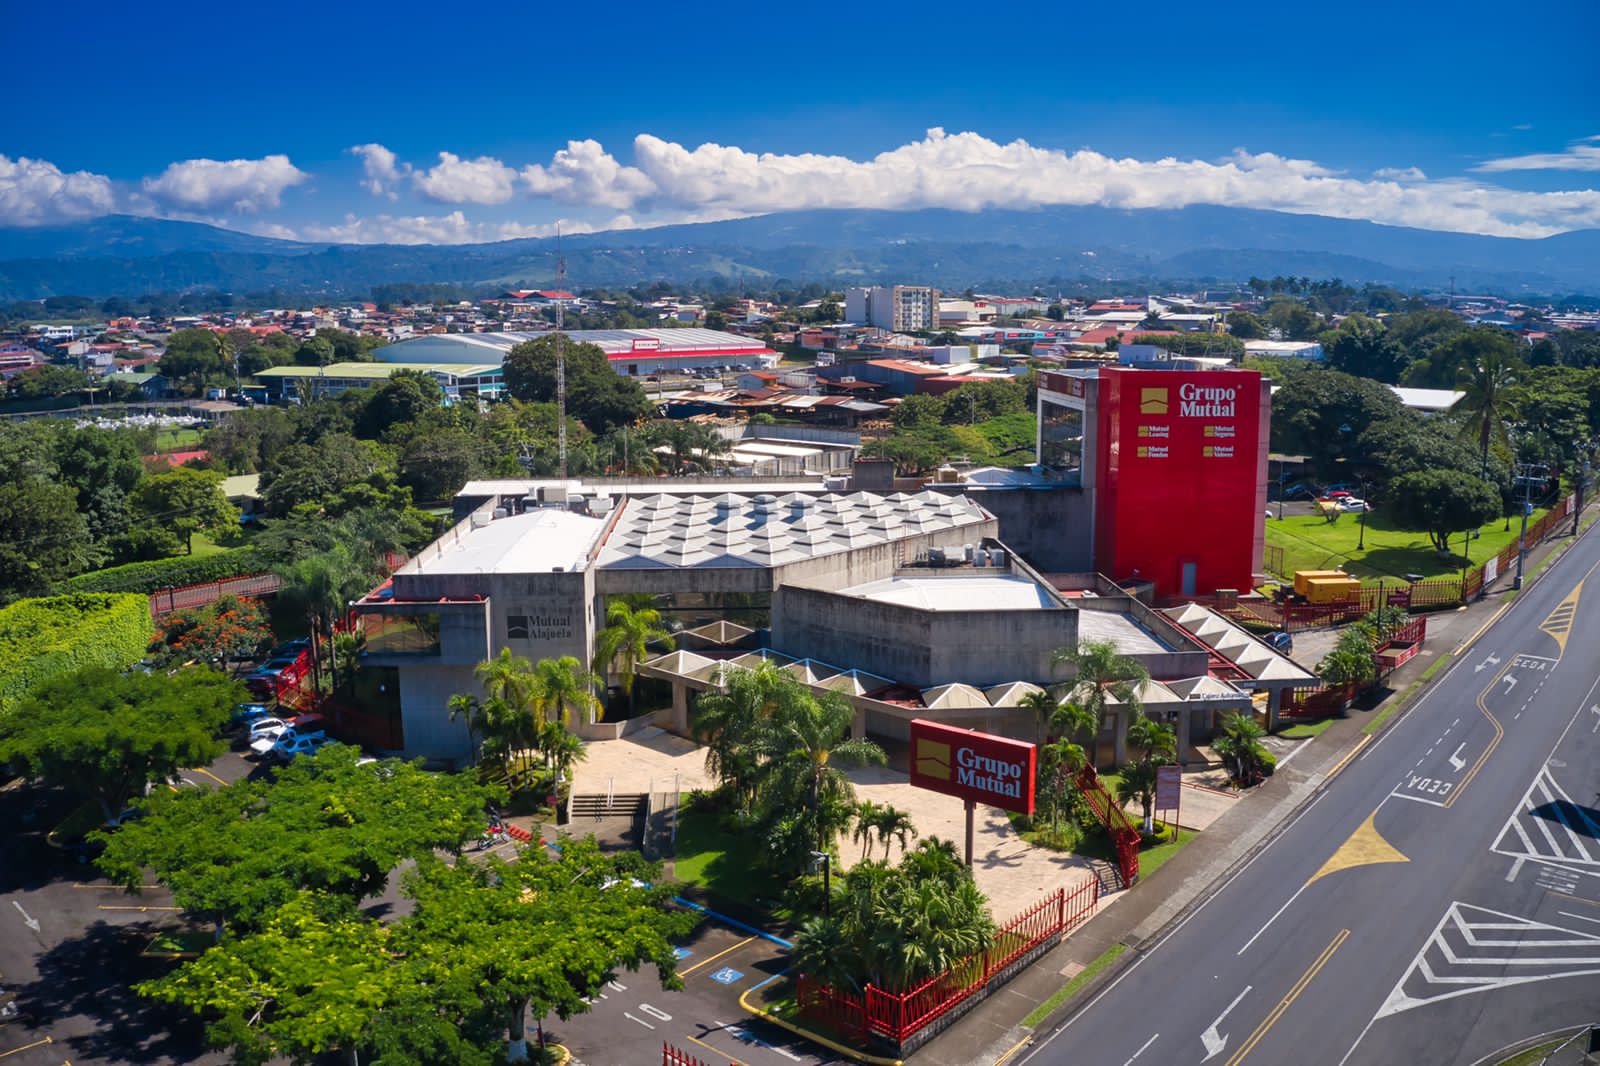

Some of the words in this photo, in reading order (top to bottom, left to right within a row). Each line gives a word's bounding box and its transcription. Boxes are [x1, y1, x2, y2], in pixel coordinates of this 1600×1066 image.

[1179, 383, 1236, 405] Grupo
[1179, 401, 1235, 417] Mutual
[528, 615, 571, 626] Mutual
[529, 627, 572, 640] Alajuela
[956, 747, 1022, 779] Grupo
[956, 766, 1021, 798] Mutual
[1407, 775, 1453, 795] CEDA
